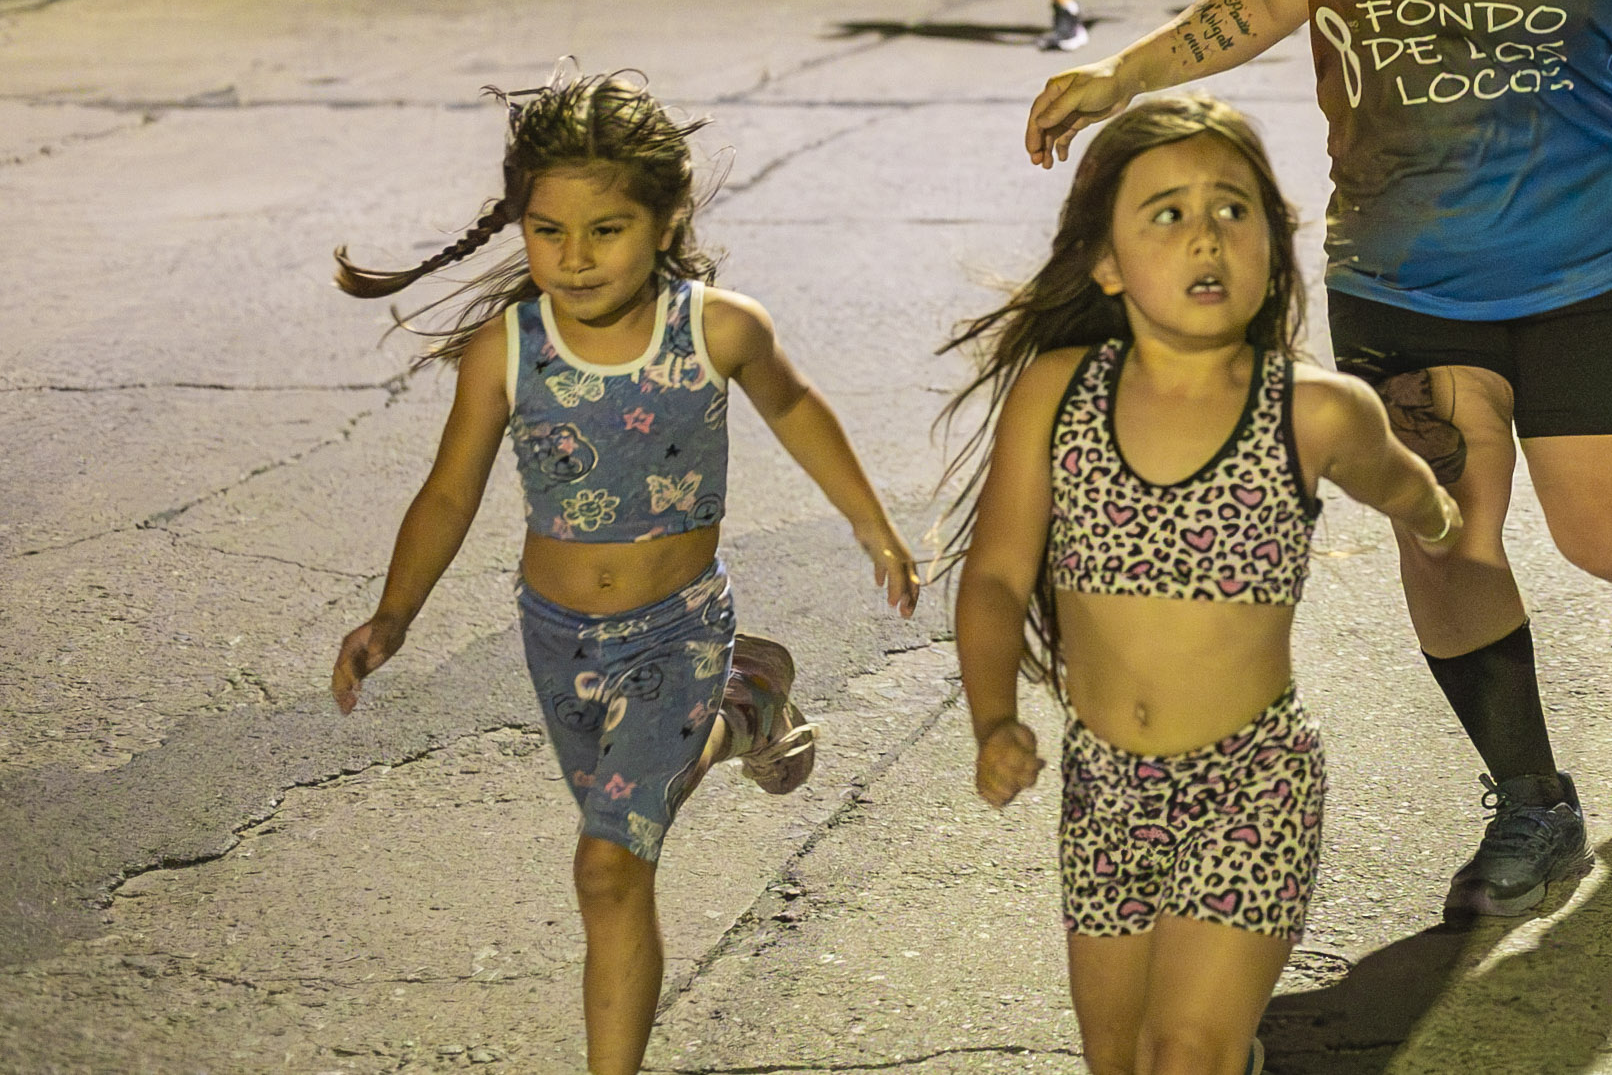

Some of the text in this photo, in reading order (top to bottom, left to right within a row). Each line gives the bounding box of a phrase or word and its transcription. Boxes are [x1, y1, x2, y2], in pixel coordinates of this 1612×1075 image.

[1361, 34, 1567, 71] DE LOS
[1396, 67, 1574, 106] LOCOS
